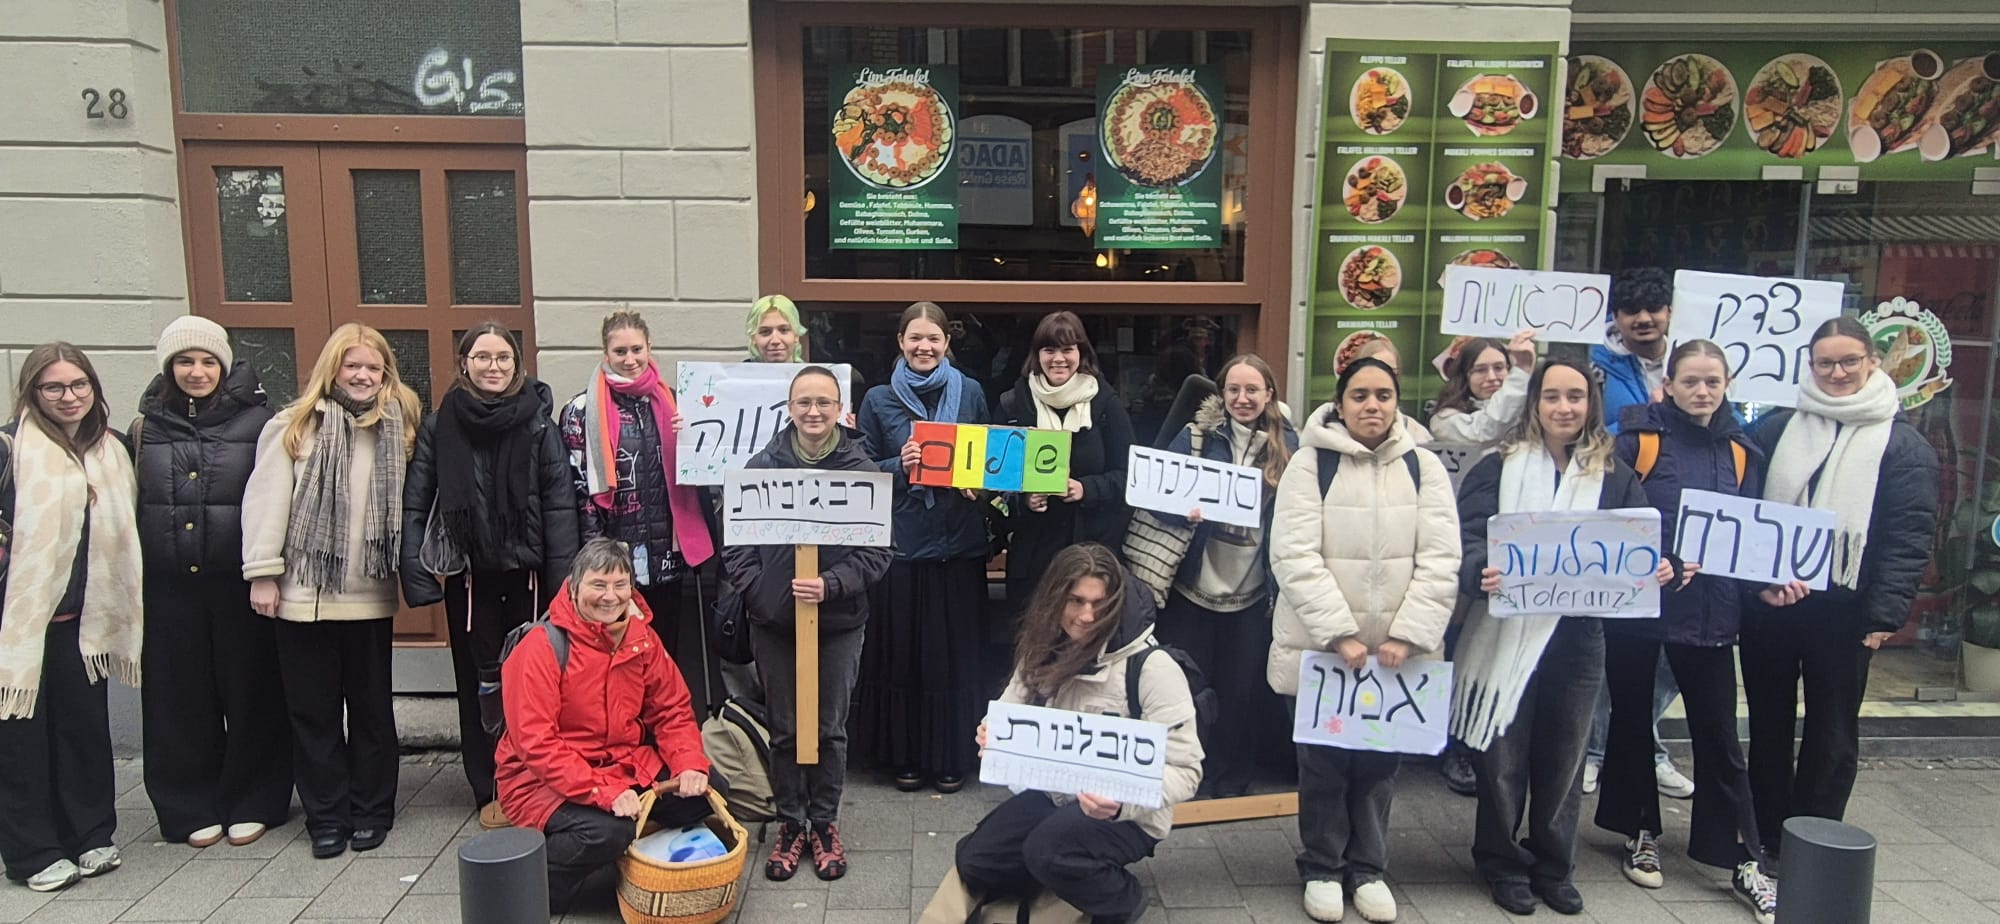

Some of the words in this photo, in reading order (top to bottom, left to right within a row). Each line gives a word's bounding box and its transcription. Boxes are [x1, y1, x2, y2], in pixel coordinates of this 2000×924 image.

[886, 67, 929, 88] Falafel
[1151, 68, 1196, 88] Falafel
[81, 88, 128, 119] 28
[1710, 282, 1802, 339] צדק
[917, 431, 1058, 481] שלום
[1131, 452, 1257, 510] סובלנות
[1499, 525, 1659, 577] סובלנות
[1508, 583, 1626, 613] Toleranz
[996, 714, 1155, 766] סובלנות
